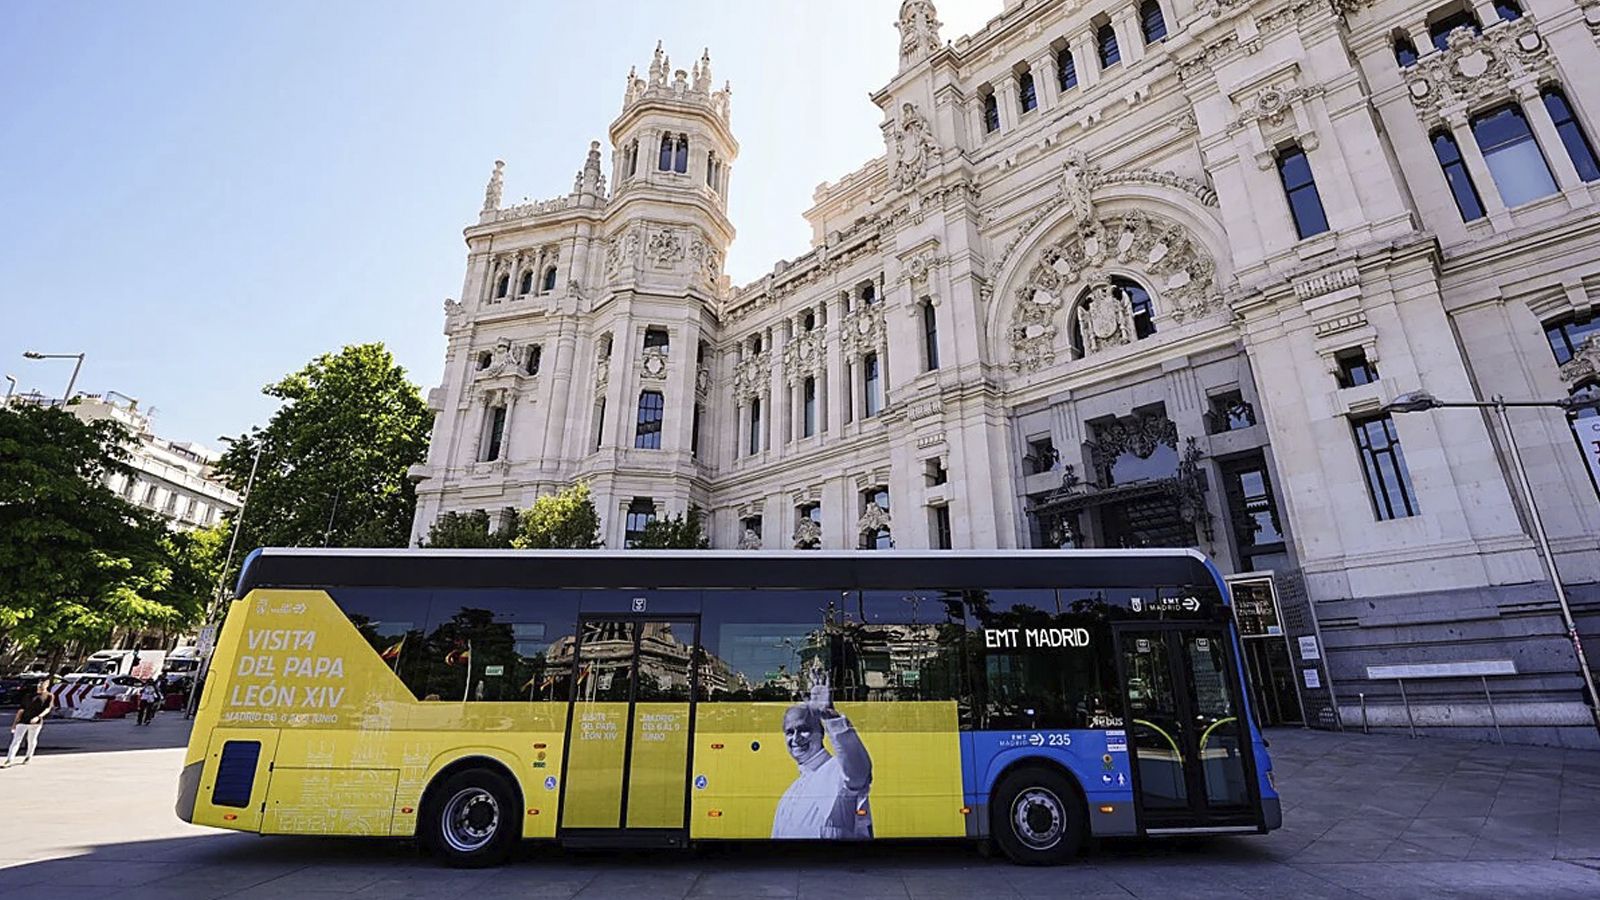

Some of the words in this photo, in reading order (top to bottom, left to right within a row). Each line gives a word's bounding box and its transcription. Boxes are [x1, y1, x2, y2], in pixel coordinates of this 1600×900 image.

[247, 629, 316, 651] VISITA
[985, 629, 1019, 648] EMT
[1025, 628, 1090, 648] MADRID
[237, 655, 275, 677] DEL
[283, 656, 344, 678] PAPA
[230, 680, 297, 708] LEÓN
[301, 686, 345, 708] XIV
[1049, 734, 1071, 746] 235
